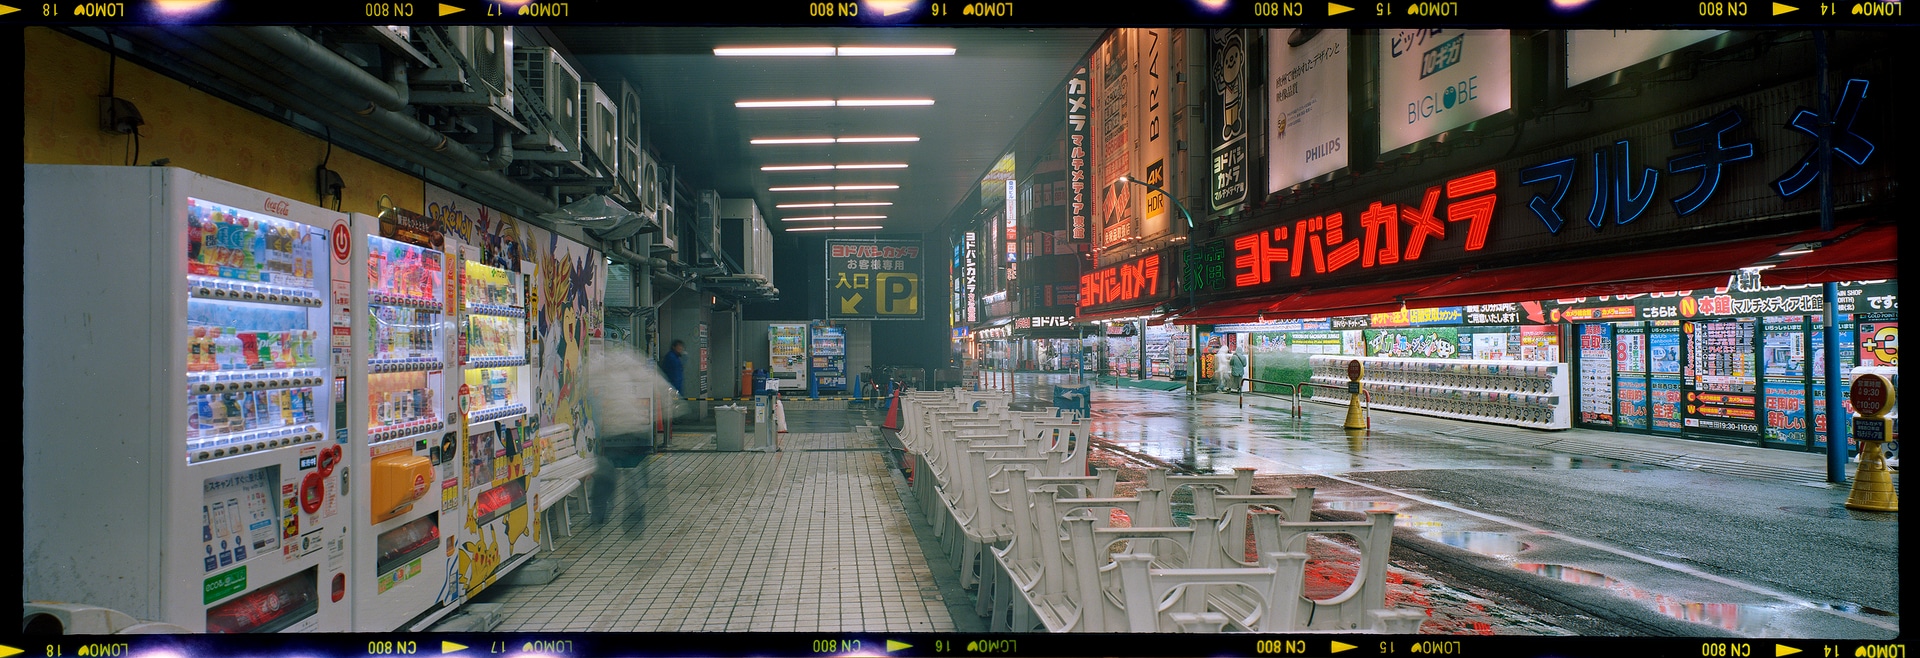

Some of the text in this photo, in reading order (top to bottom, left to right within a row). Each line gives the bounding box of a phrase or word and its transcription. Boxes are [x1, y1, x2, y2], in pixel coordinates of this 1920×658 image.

[43, 3, 123, 17] LOMO 18
[366, 3, 413, 16] CN 800
[530, 3, 568, 16] LOMO
[810, 3, 857, 16] CN 800
[932, 3, 1012, 16] LOMO 16
[1255, 3, 1302, 16] CN 800
[1377, 3, 1457, 16] LOMO 15
[1699, 2, 1747, 16] CN 800
[1821, 2, 1902, 16] LOMO 14
[1408, 75, 1477, 124] BIGLOBE
[1305, 137, 1341, 163] PHILIPS
[1519, 78, 1875, 234] マルチメ
[1213, 147, 1245, 174] ヨドバシ
[1147, 164, 1162, 185] 4K
[1217, 166, 1241, 190] カメラ
[1147, 192, 1164, 214] HDR
[1235, 171, 1497, 287] ヨドバシカメラ
[832, 244, 919, 258] ヨドバシカメラ
[847, 259, 904, 270] お客様専用
[966, 232, 977, 293] ヨドバシカメラ
[835, 272, 870, 290] 入口
[1081, 254, 1159, 307] ヨドバシカメラ
[884, 276, 912, 313] P
[1642, 306, 1677, 318] こちらは
[1581, 335, 1601, 349] 買取
[1863, 388, 1880, 396] 9:30
[1860, 401, 1880, 409] 10:00
[47, 644, 128, 657] LOMO 18
[368, 640, 416, 652] CN 800
[813, 640, 861, 653] CN 800
[935, 640, 951, 653] 16
[1257, 640, 1305, 653] CN 800
[1380, 640, 1460, 654] LOMO 15
[1702, 643, 1750, 657] CN 800
[1824, 644, 1905, 658] LOMO 14
